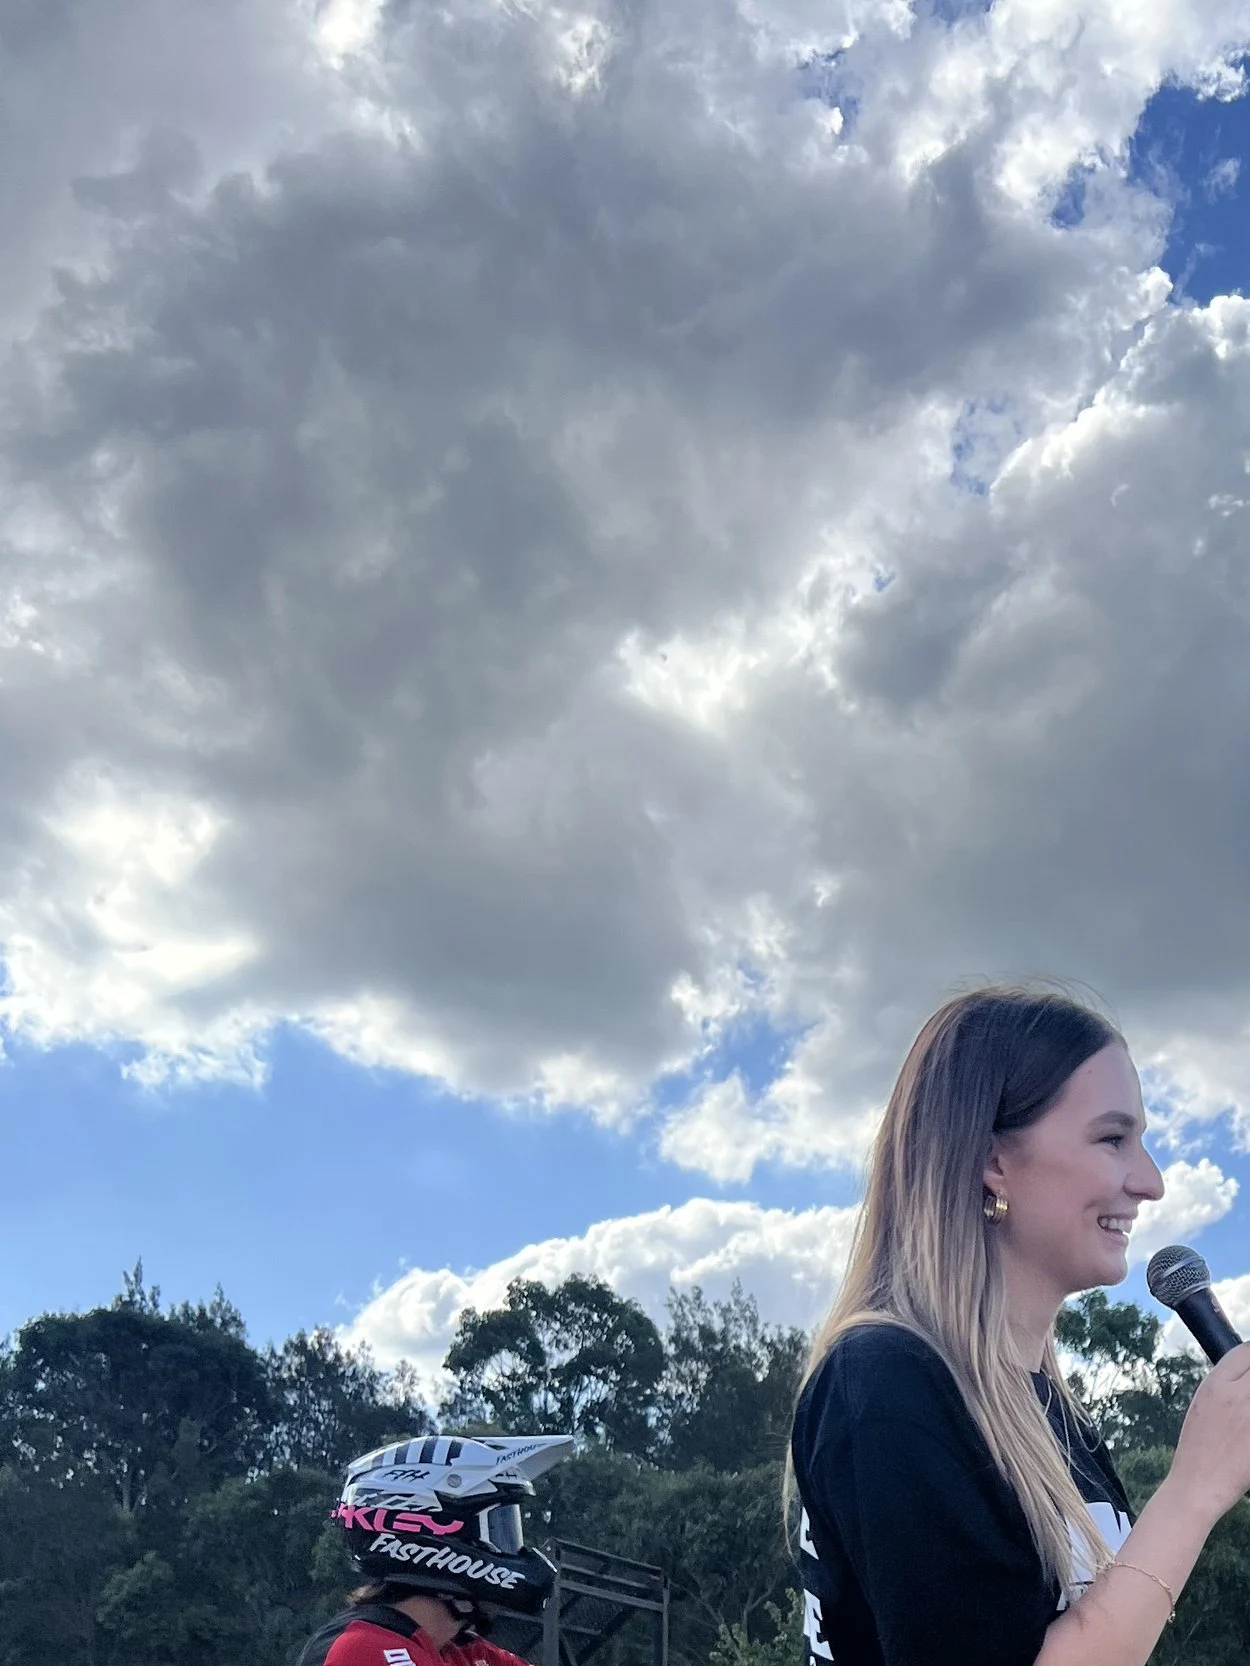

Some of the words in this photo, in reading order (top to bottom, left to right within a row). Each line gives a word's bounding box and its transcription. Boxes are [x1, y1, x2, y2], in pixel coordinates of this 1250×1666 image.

[495, 1443, 548, 1466] FASTHOU
[330, 1502, 464, 1535] KLEY
[369, 1533, 527, 1590] FASTHOUSE
